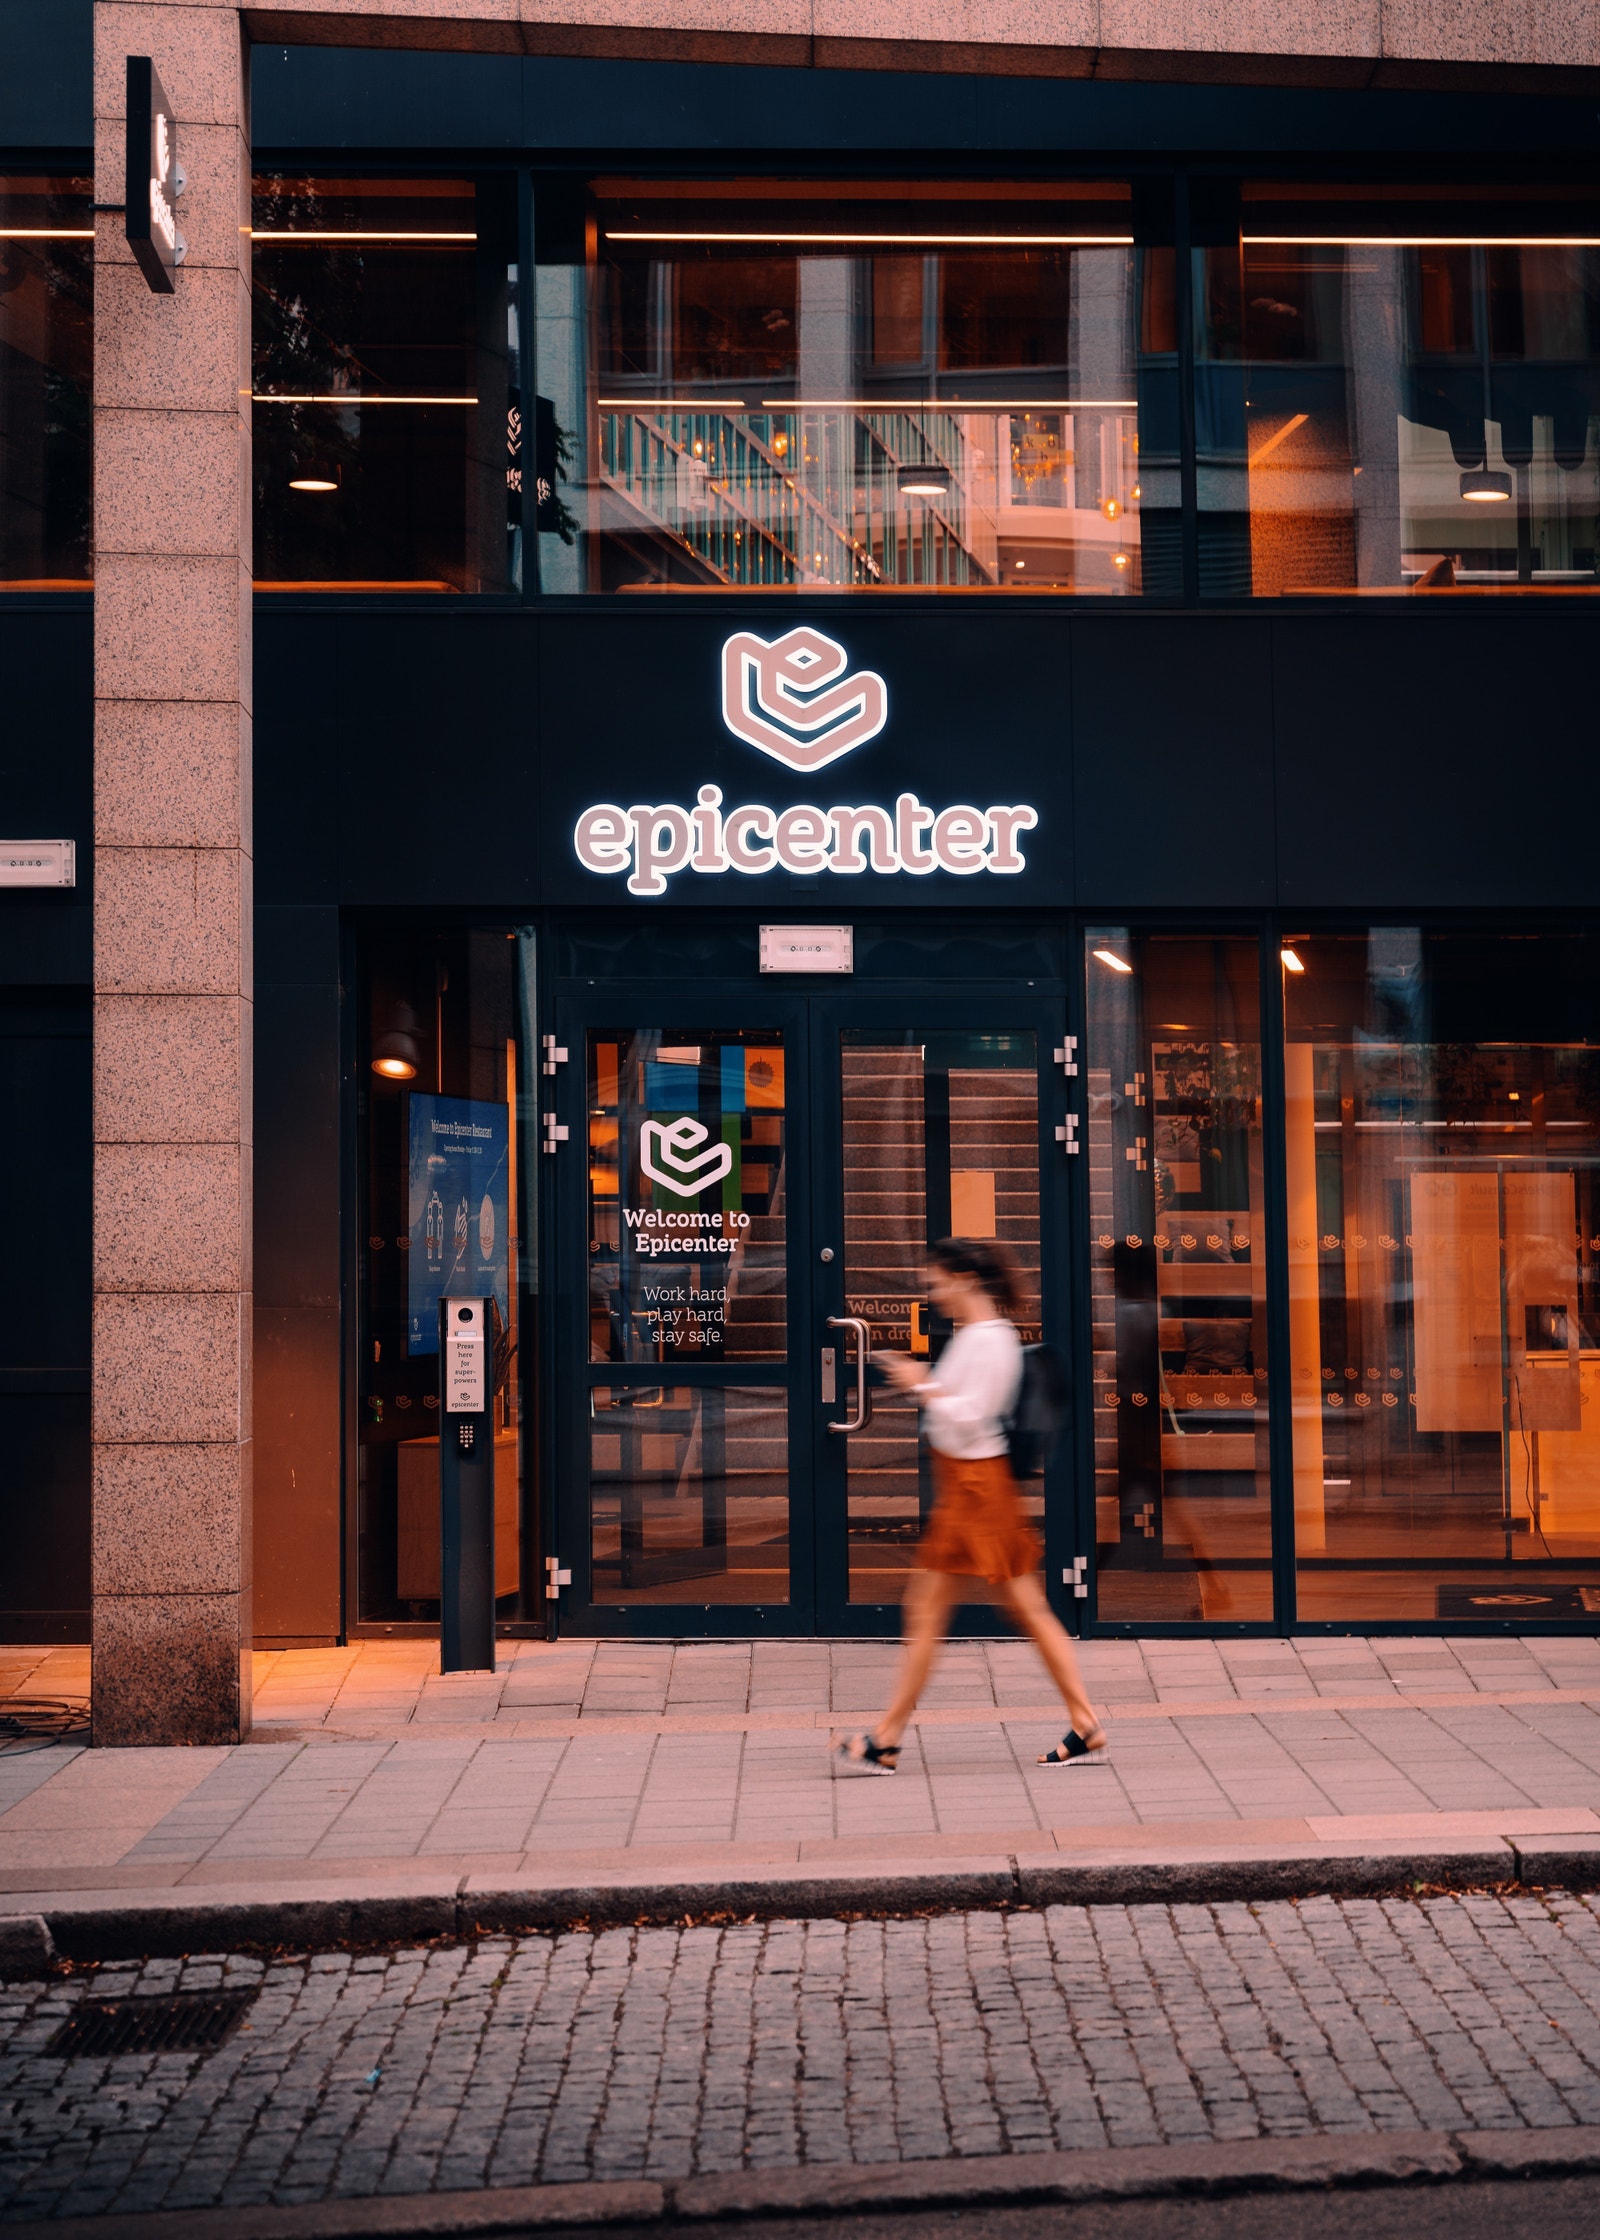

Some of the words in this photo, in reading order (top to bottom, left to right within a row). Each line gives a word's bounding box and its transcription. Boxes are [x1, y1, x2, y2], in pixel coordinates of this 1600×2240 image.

[574, 783, 1039, 895] epicenter
[622, 1208, 723, 1228] Welcome
[728, 1210, 750, 1228] to
[635, 1233, 739, 1257] Epicenter
[643, 1286, 685, 1301] Work
[689, 1286, 731, 1304] hard,
[647, 1307, 681, 1325] play
[686, 1307, 728, 1324] hard,
[848, 1300, 912, 1314] Welcom
[651, 1330, 685, 1346] stay
[688, 1327, 723, 1346] safe.
